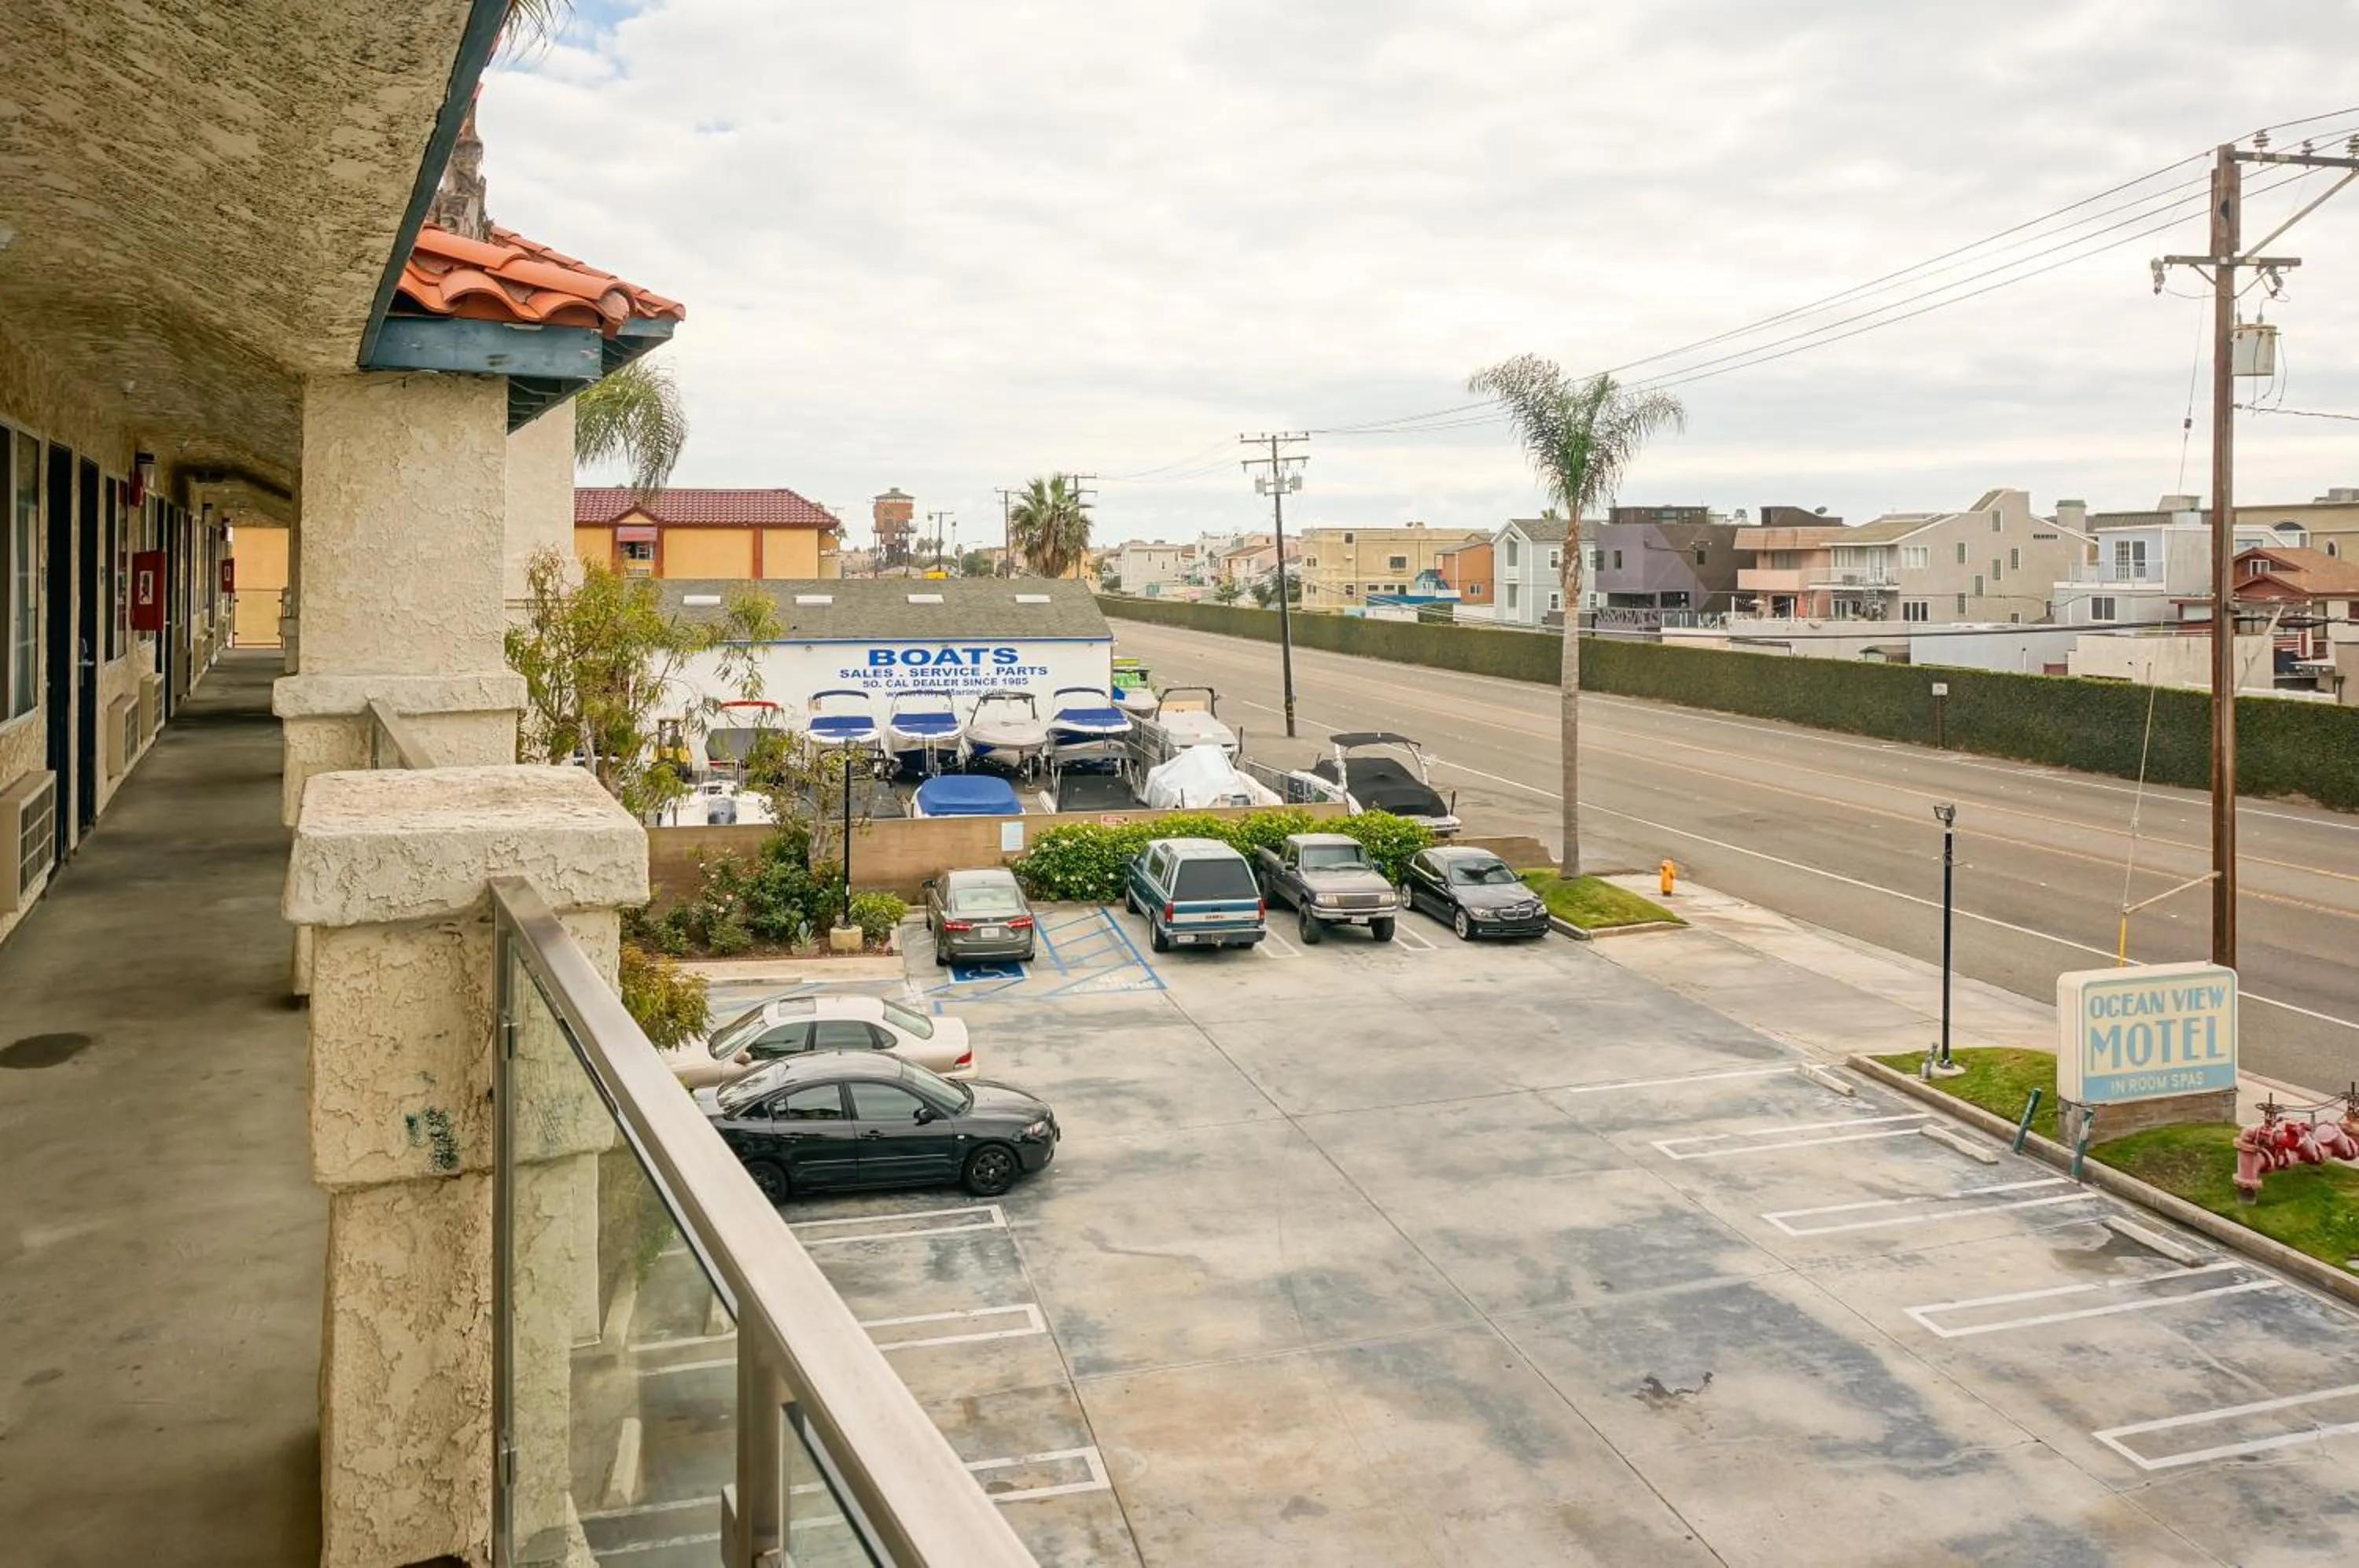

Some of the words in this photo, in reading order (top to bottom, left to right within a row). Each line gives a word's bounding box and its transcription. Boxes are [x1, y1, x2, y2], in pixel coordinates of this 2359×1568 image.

[868, 647, 1019, 666] BOATS
[840, 668, 893, 679] SALES
[909, 668, 981, 677] SERVICE
[995, 666, 1048, 675] PARTS
[886, 679, 908, 688] CAL
[913, 679, 958, 687] DEALER
[2089, 989, 2166, 1019] OCEAN
[2171, 985, 2225, 1012] VIEW
[2090, 1016, 2226, 1070] MOTEL
[2111, 1080, 2125, 1094] IN
[2129, 1076, 2166, 1094] ROOM
[2170, 1071, 2204, 1088] SPAS
